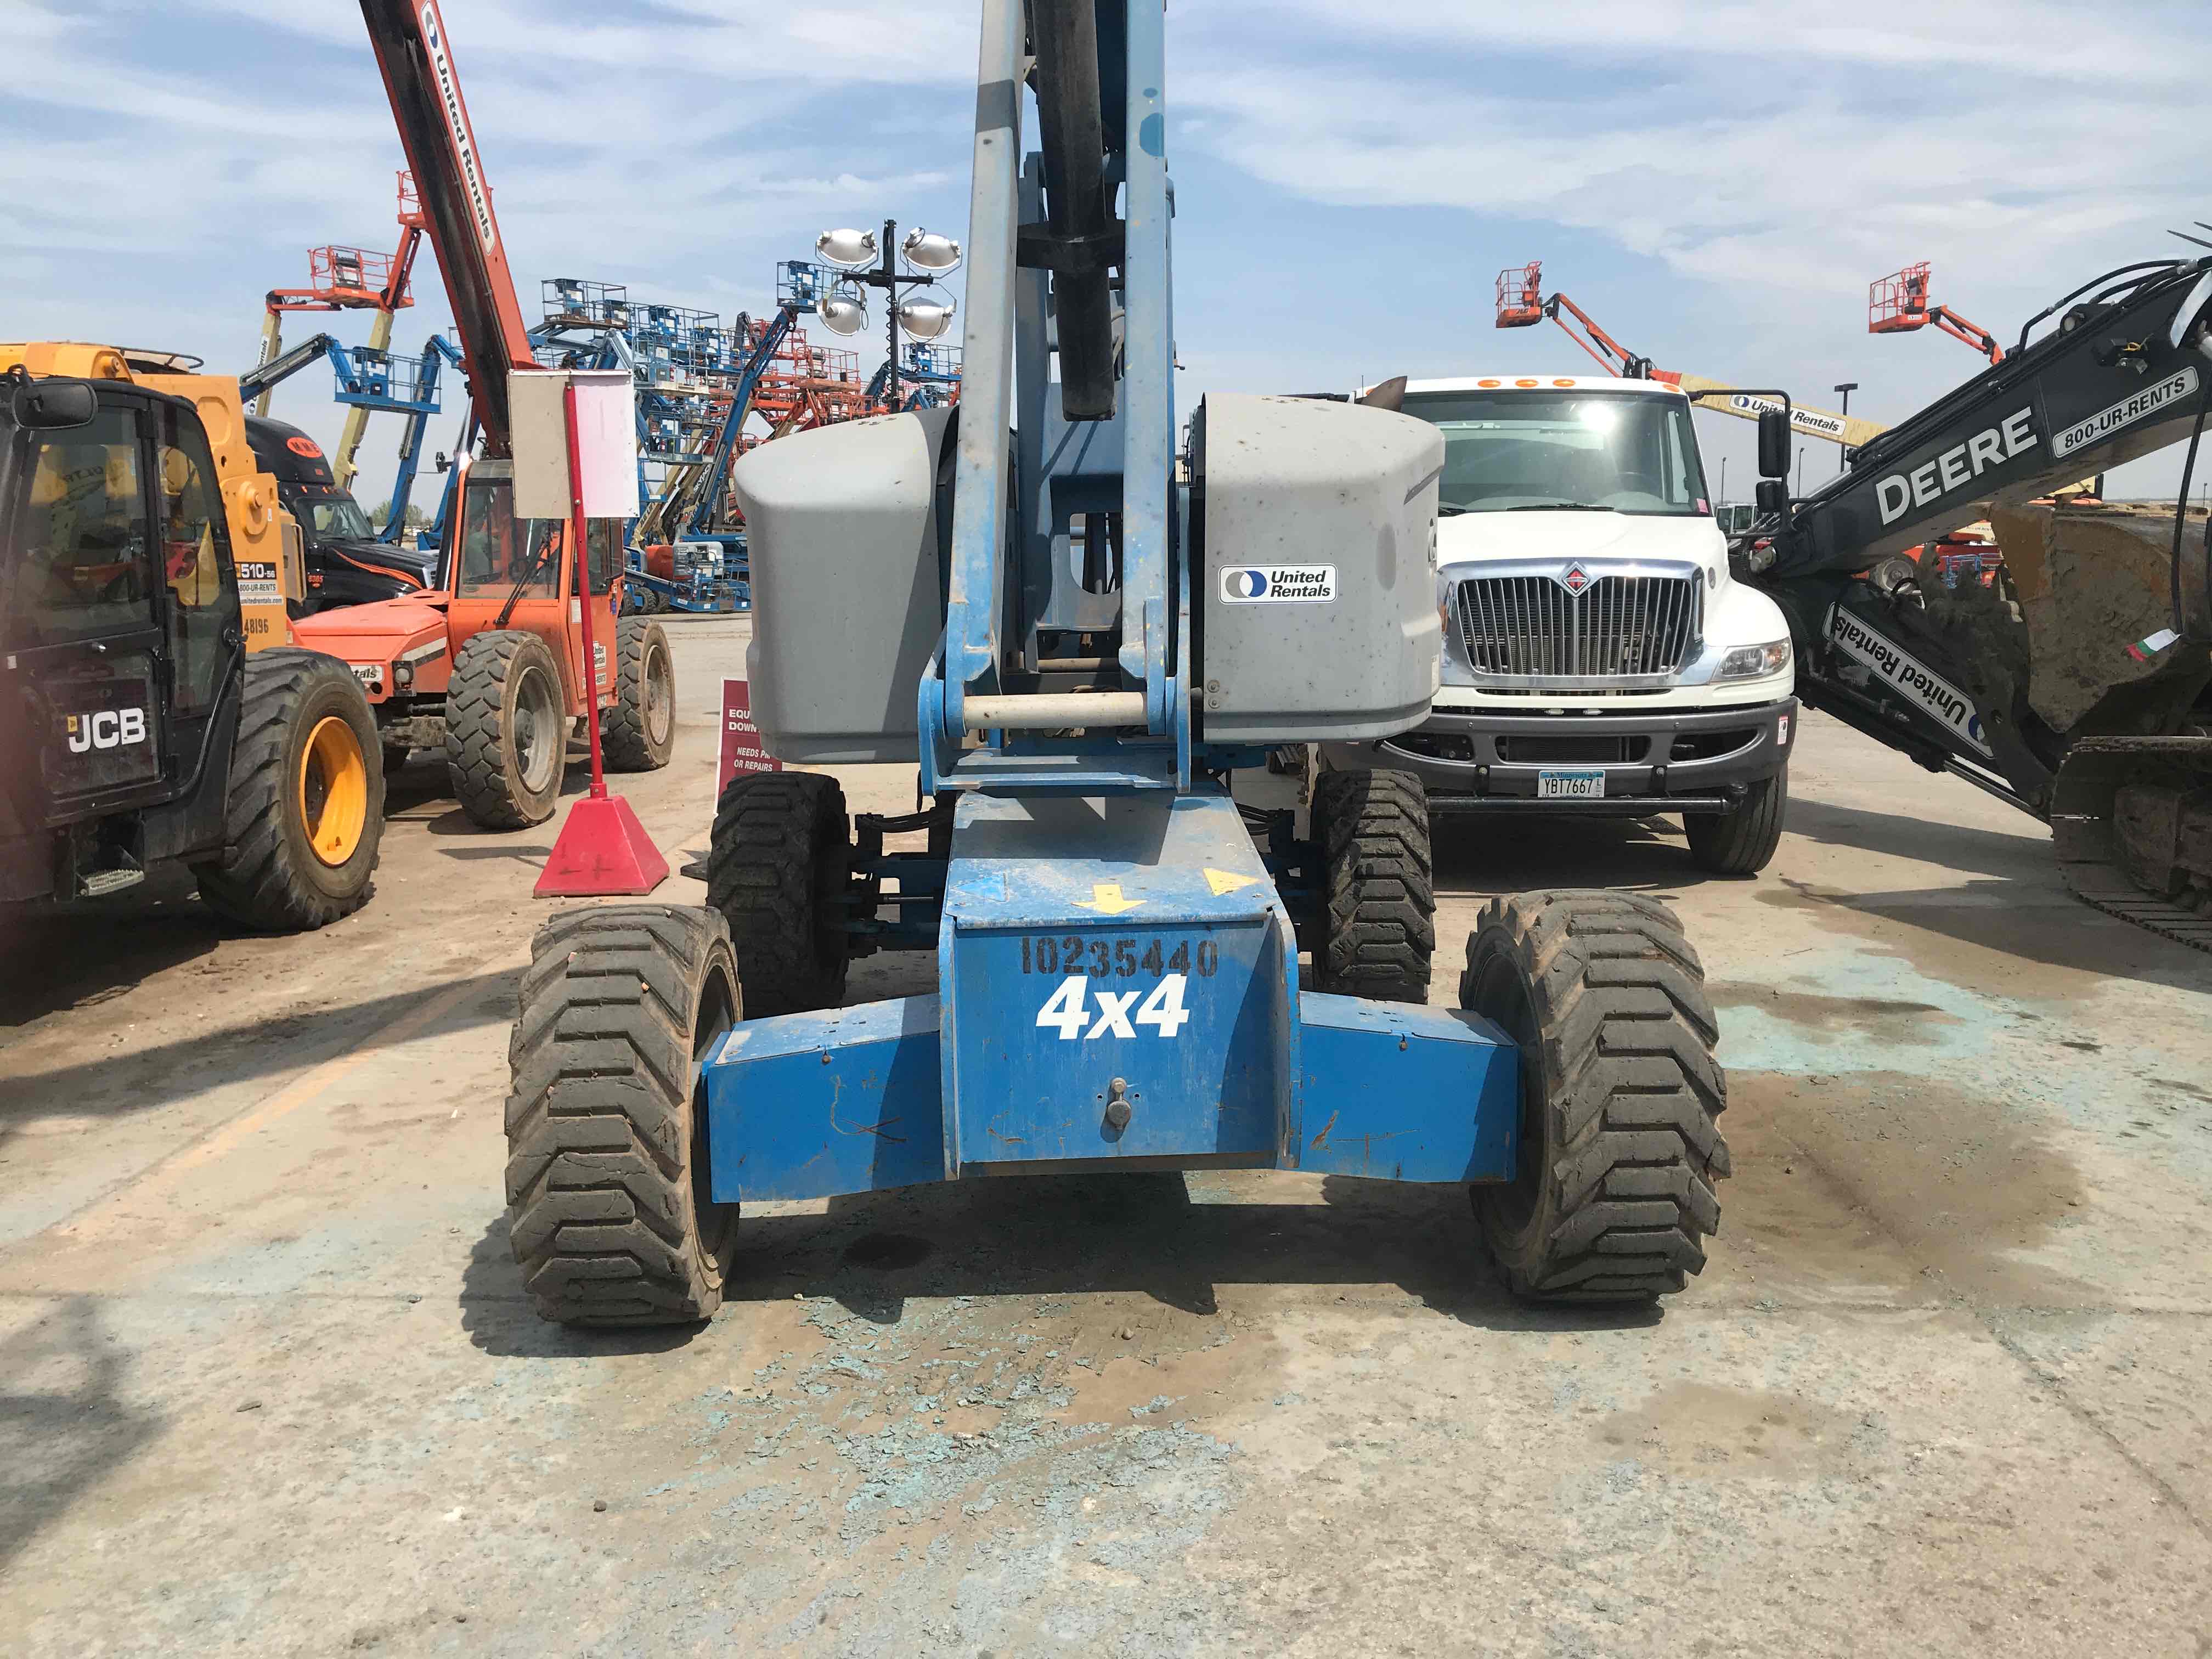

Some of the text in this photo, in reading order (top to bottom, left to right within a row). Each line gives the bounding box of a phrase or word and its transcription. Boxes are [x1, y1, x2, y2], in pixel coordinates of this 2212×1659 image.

[437, 54, 489, 239] United Rentals
[1794, 411, 1839, 432] Rentals
[2064, 376, 2186, 449] 800-UR-RENTS
[1875, 406, 2038, 526] DEERE
[1270, 584, 1331, 597] Rentals
[1271, 571, 1326, 583] United
[354, 668, 378, 679] tals
[1835, 616, 1967, 725] United Rentals
[69, 708, 146, 753] JCB
[733, 759, 773, 772] OR REPAIRS
[737, 746, 759, 758] NEEDS
[1544, 778, 1594, 794] YBT7667
[1022, 936, 1218, 978] 10235440
[1035, 973, 1190, 1040] 4x4
